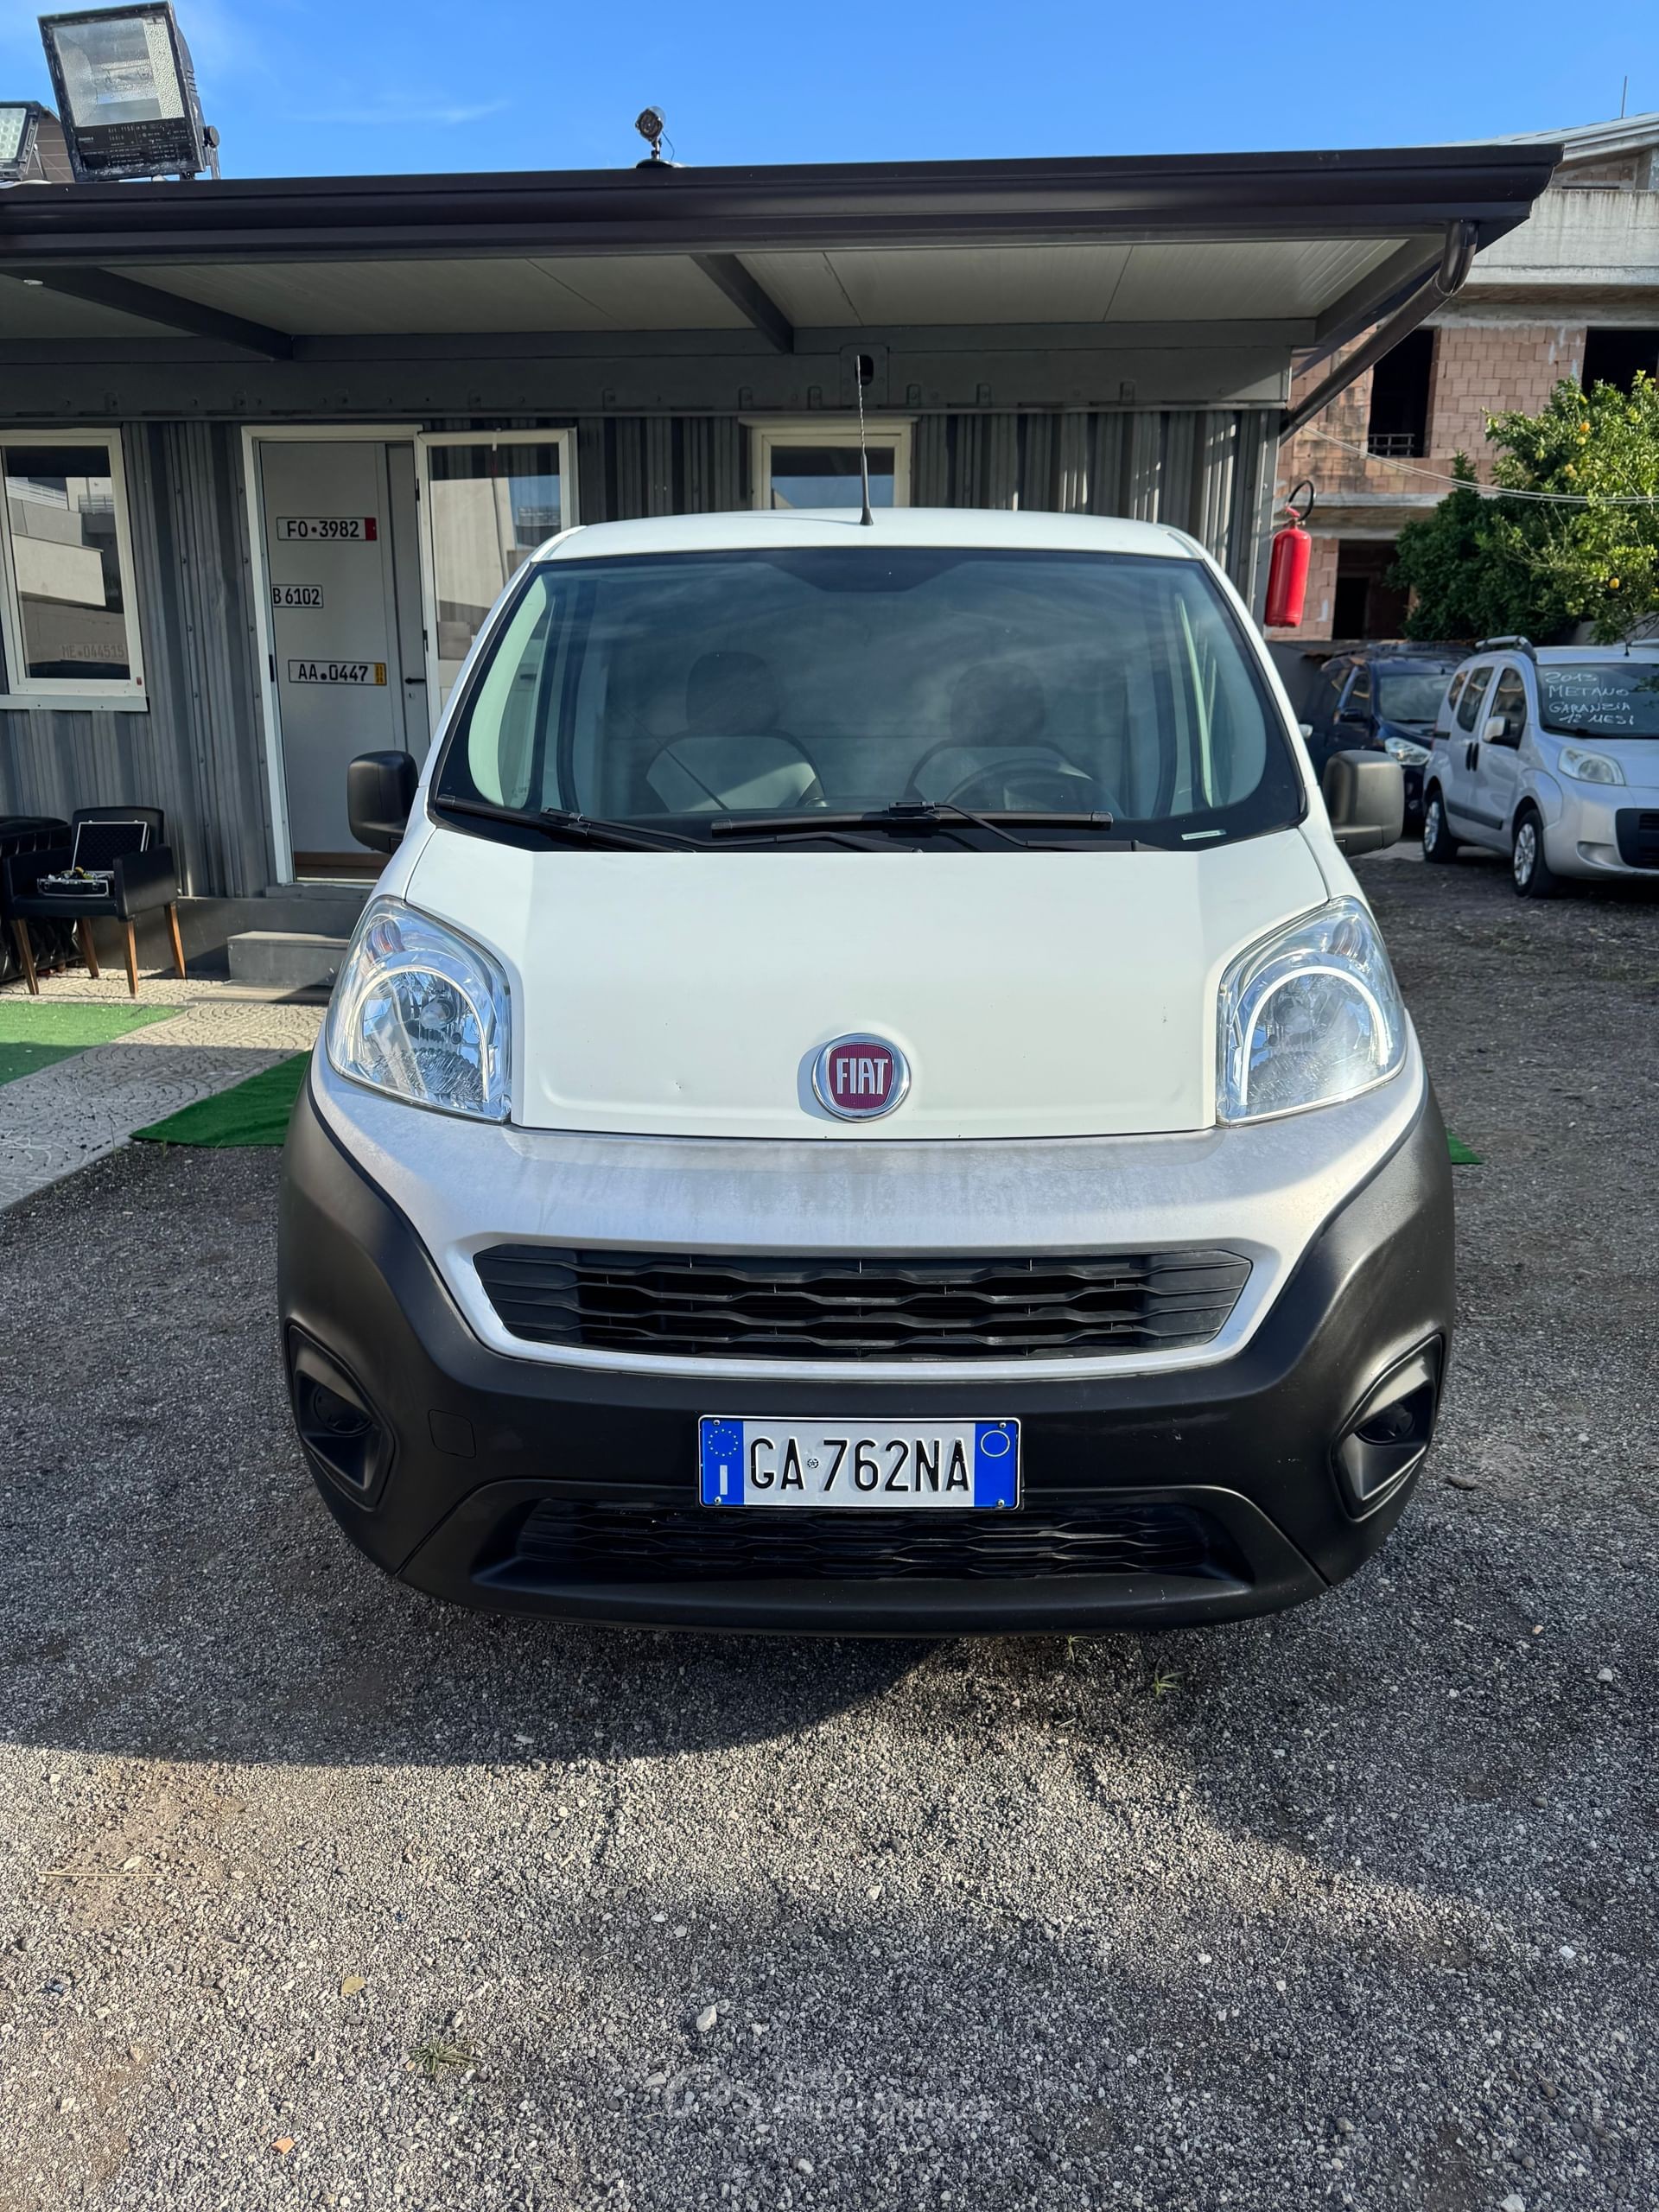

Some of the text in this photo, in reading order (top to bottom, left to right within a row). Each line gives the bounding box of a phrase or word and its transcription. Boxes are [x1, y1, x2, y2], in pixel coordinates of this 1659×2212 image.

[285, 588, 321, 605] 6102
[1544, 671, 1597, 683] 2013
[1548, 684, 1629, 698] METANO
[1548, 702, 1630, 713] GARANZIA
[836, 1058, 889, 1095] FIAT
